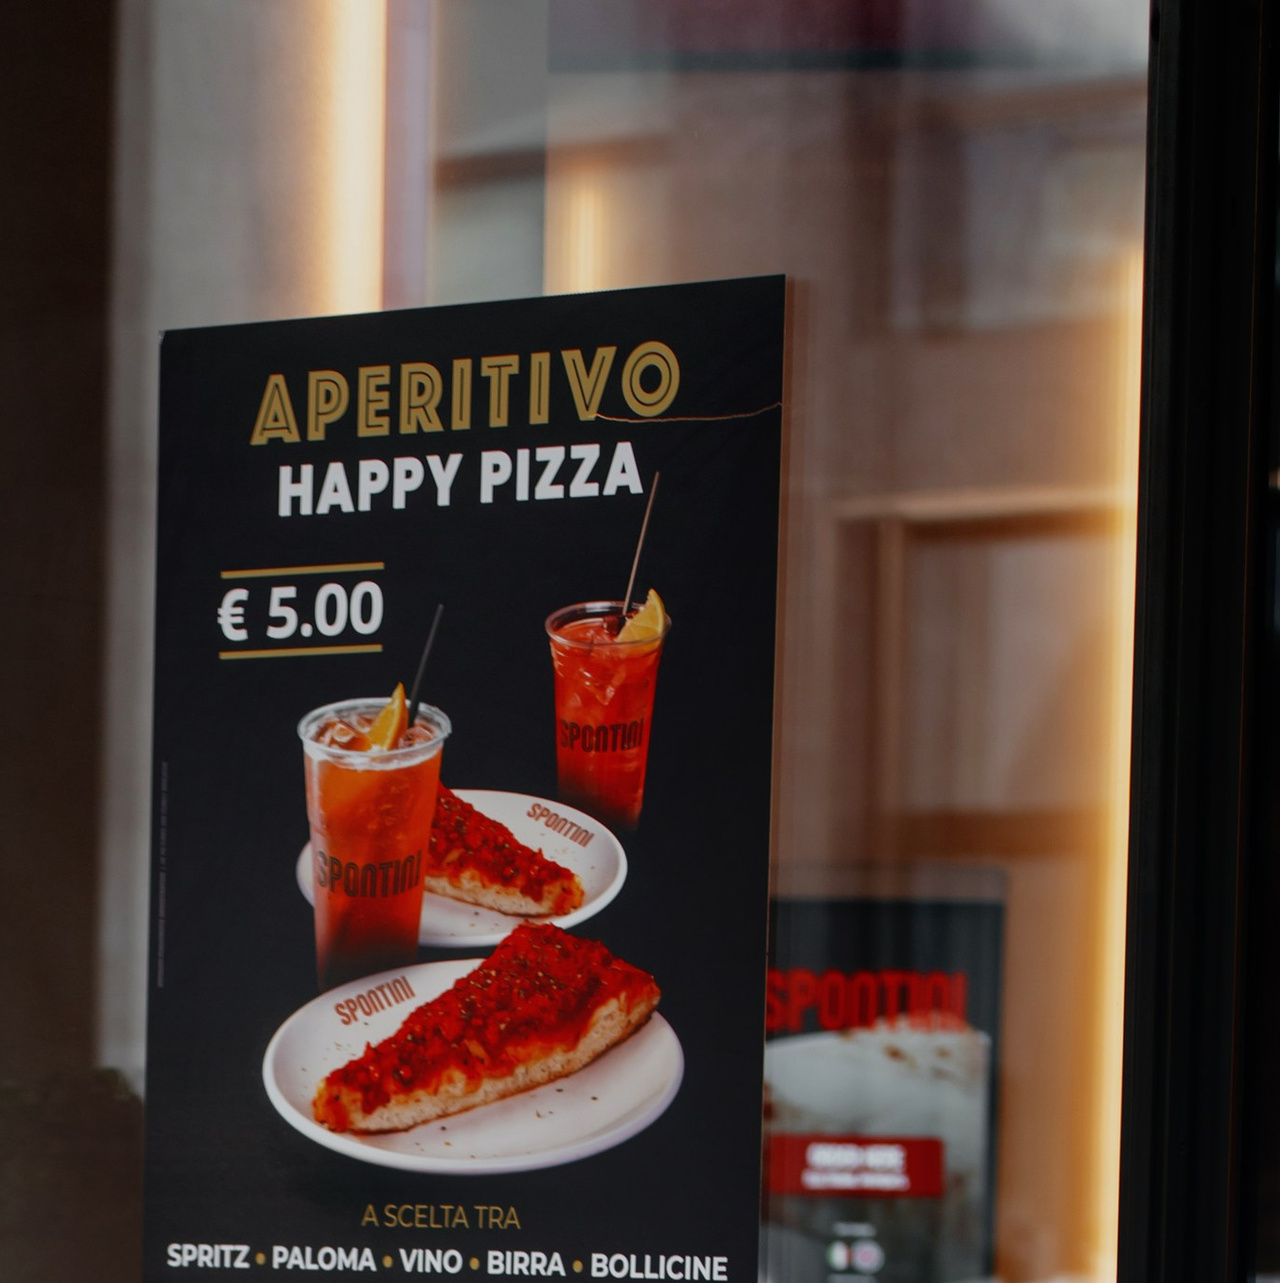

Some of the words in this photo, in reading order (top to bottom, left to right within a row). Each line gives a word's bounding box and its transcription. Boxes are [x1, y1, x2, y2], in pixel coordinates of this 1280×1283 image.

[250, 341, 680, 445] APERITIVO
[278, 453, 464, 517] HAPPY
[480, 441, 644, 504] PIZZA
[217, 588, 249, 642] €
[266, 581, 384, 639] 5.00
[561, 717, 645, 753] SPONTINI
[526, 803, 595, 848] SPONTINI
[316, 850, 422, 899] SPONTINI
[334, 975, 416, 1026] SPONTINI
[361, 1203, 379, 1227] A
[384, 1204, 470, 1228] SCELTA
[473, 1205, 521, 1230] TRA
[166, 1242, 251, 1269] SPRITZ
[272, 1245, 378, 1272] PALOMA
[398, 1248, 463, 1274] VINO
[487, 1250, 567, 1277] BIRRA
[590, 1252, 729, 1282] BOLLICINE
